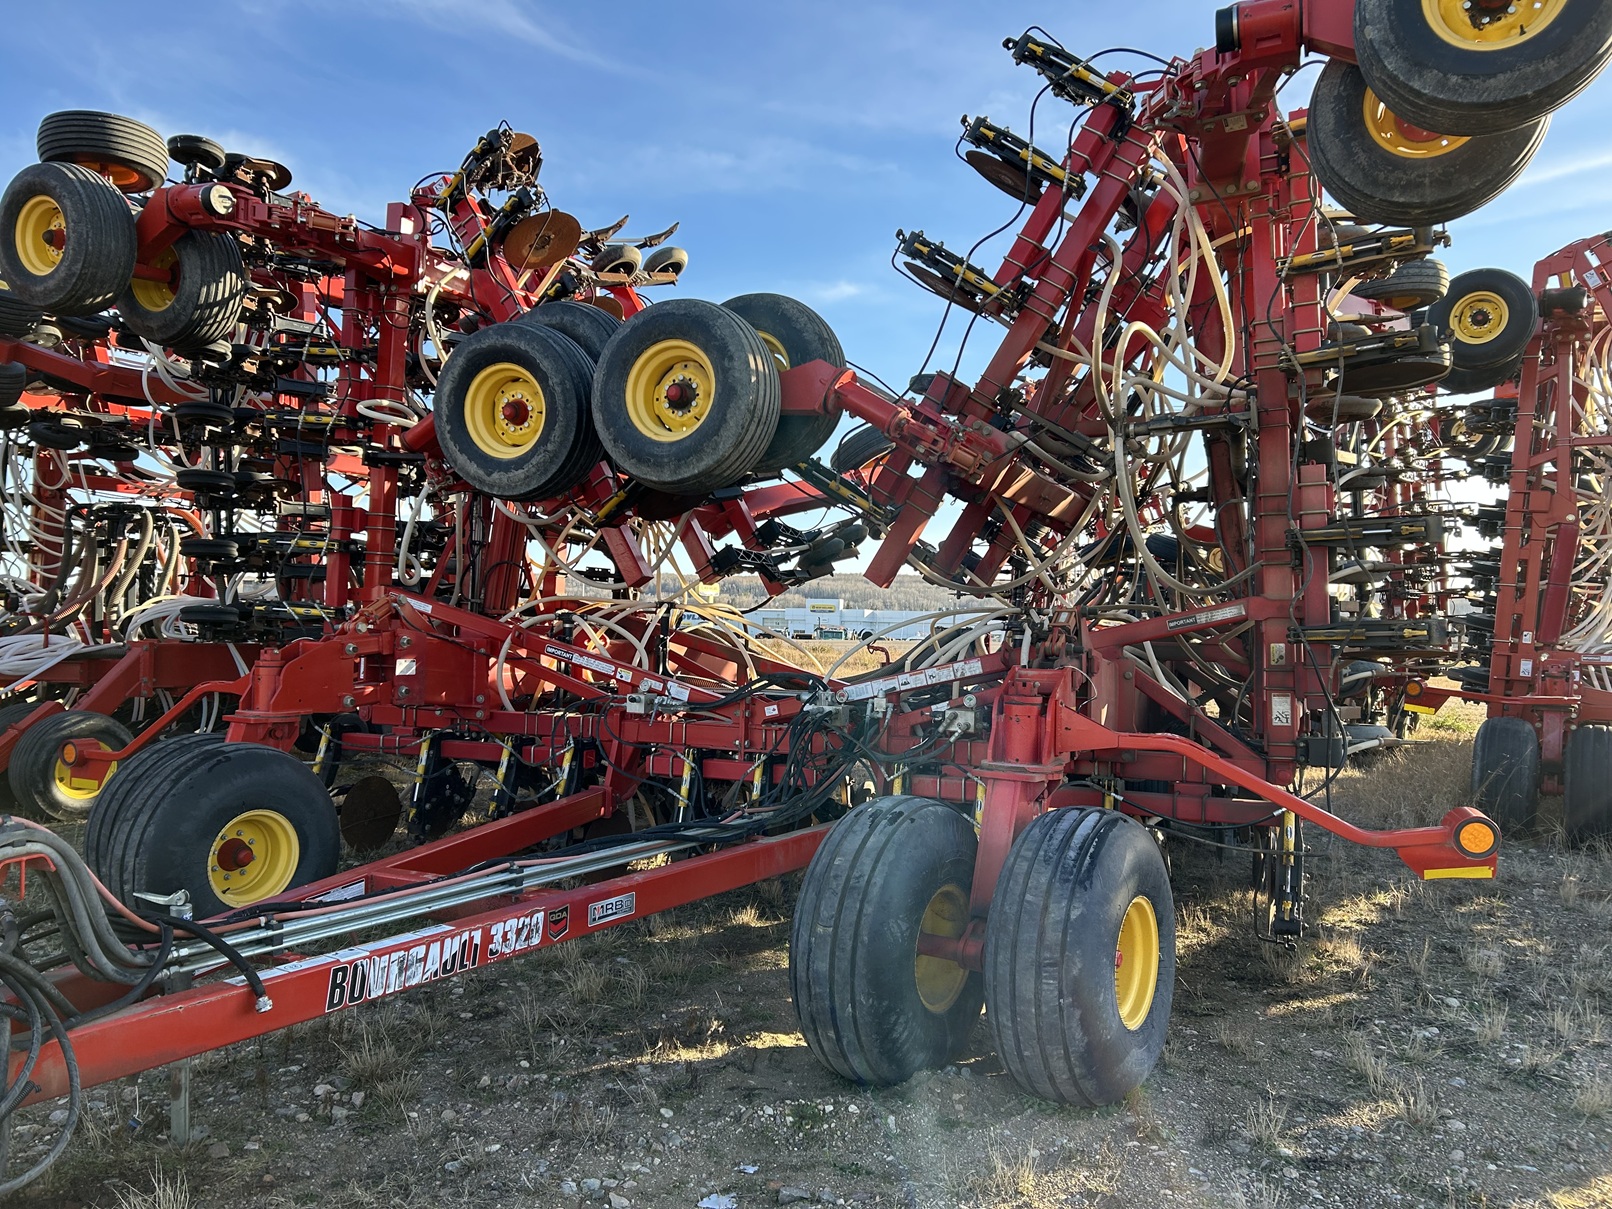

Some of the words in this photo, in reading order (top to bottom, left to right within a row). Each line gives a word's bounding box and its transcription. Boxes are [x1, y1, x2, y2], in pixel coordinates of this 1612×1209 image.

[1168, 617, 1197, 628] IMPORTANT
[546, 646, 573, 660] IMPORTANT
[592, 899, 624, 918] MRB
[487, 911, 545, 959] 3320
